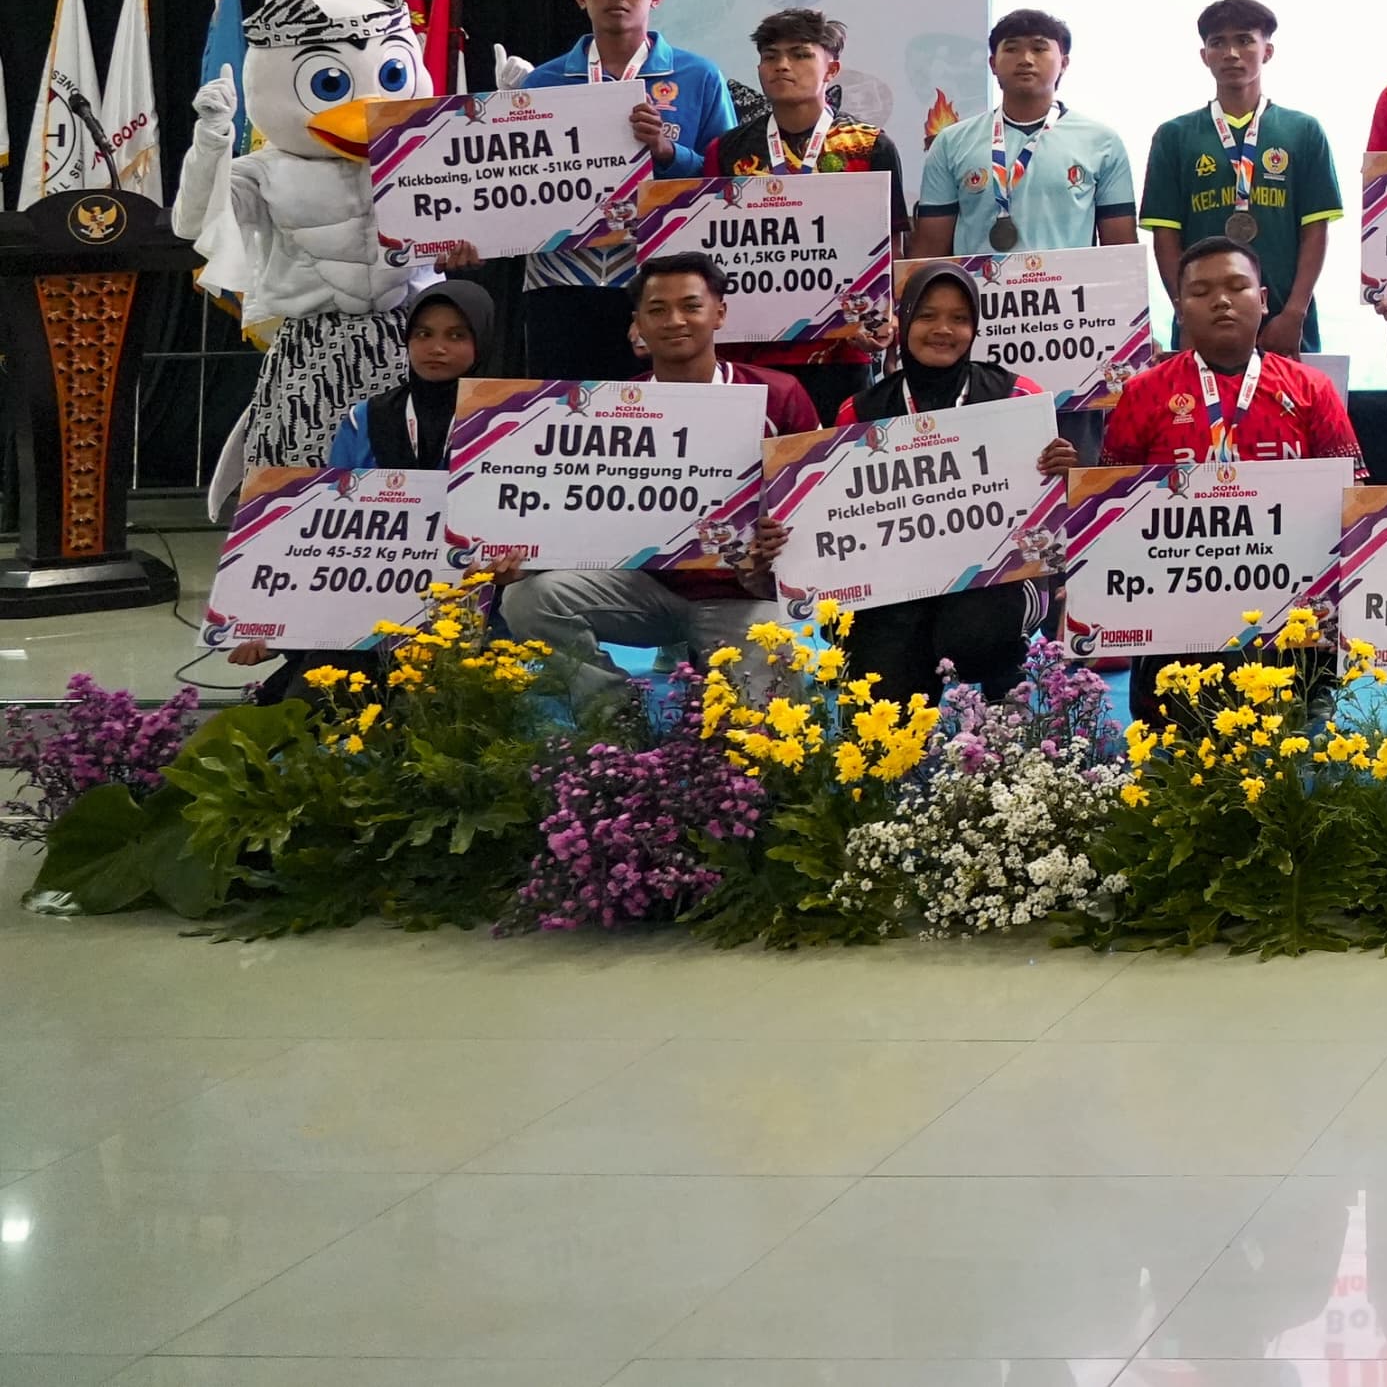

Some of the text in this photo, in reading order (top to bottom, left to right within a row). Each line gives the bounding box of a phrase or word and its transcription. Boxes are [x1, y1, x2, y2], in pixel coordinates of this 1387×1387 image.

[443, 126, 580, 166] JUARA 1
[398, 155, 626, 188] Kickboxing, LOW KICK -51KG PUTRA
[414, 178, 614, 221] Rp. 500.000,-
[701, 216, 824, 248] JUARA 1
[733, 248, 837, 265] 61,5KG PUTRA
[986, 317, 1116, 336] Silat Kelas G Putra
[987, 336, 1115, 364] 500.000,-
[534, 425, 688, 458] JUARA 1
[481, 462, 732, 480] Renang 50M Punggung Putra
[845, 445, 989, 499] JUARA 1
[498, 483, 723, 517] Rp. 500.000,-
[828, 478, 1009, 522] Pickleball Ganda Putri
[1194, 490, 1257, 498] BOJONEGORO
[1142, 503, 1282, 540] JUARA 1
[285, 545, 438, 562] Judo 45-52 Kg Putri
[1148, 543, 1273, 560] Catur Cepat Mix
[1106, 563, 1314, 602] Rp. 750.000,-
